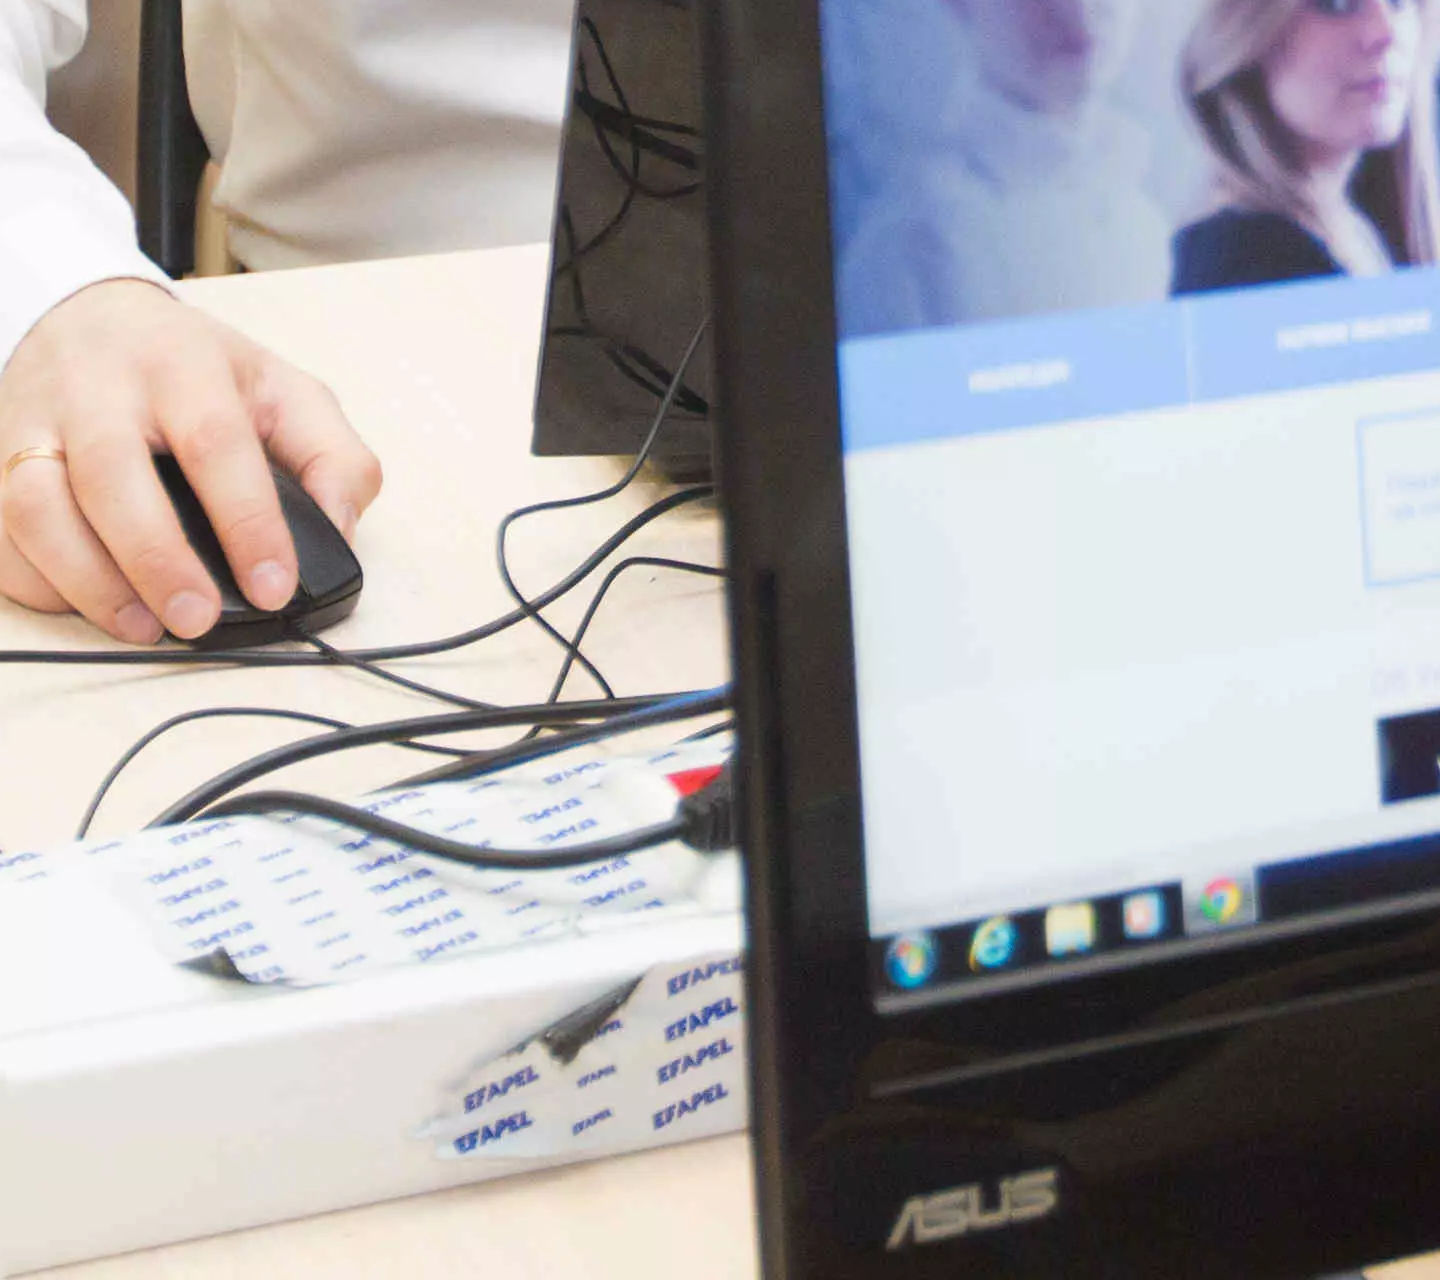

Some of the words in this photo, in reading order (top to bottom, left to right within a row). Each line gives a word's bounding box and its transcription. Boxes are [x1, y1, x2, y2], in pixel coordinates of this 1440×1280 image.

[664, 997, 739, 1042] EFAPEL
[656, 1038, 734, 1084] EFAPEL
[463, 1065, 541, 1114] EFAPEL
[652, 1082, 729, 1130] EFAPEL
[452, 1109, 535, 1154] EFAPEL
[885, 1165, 1059, 1251] ASUS
